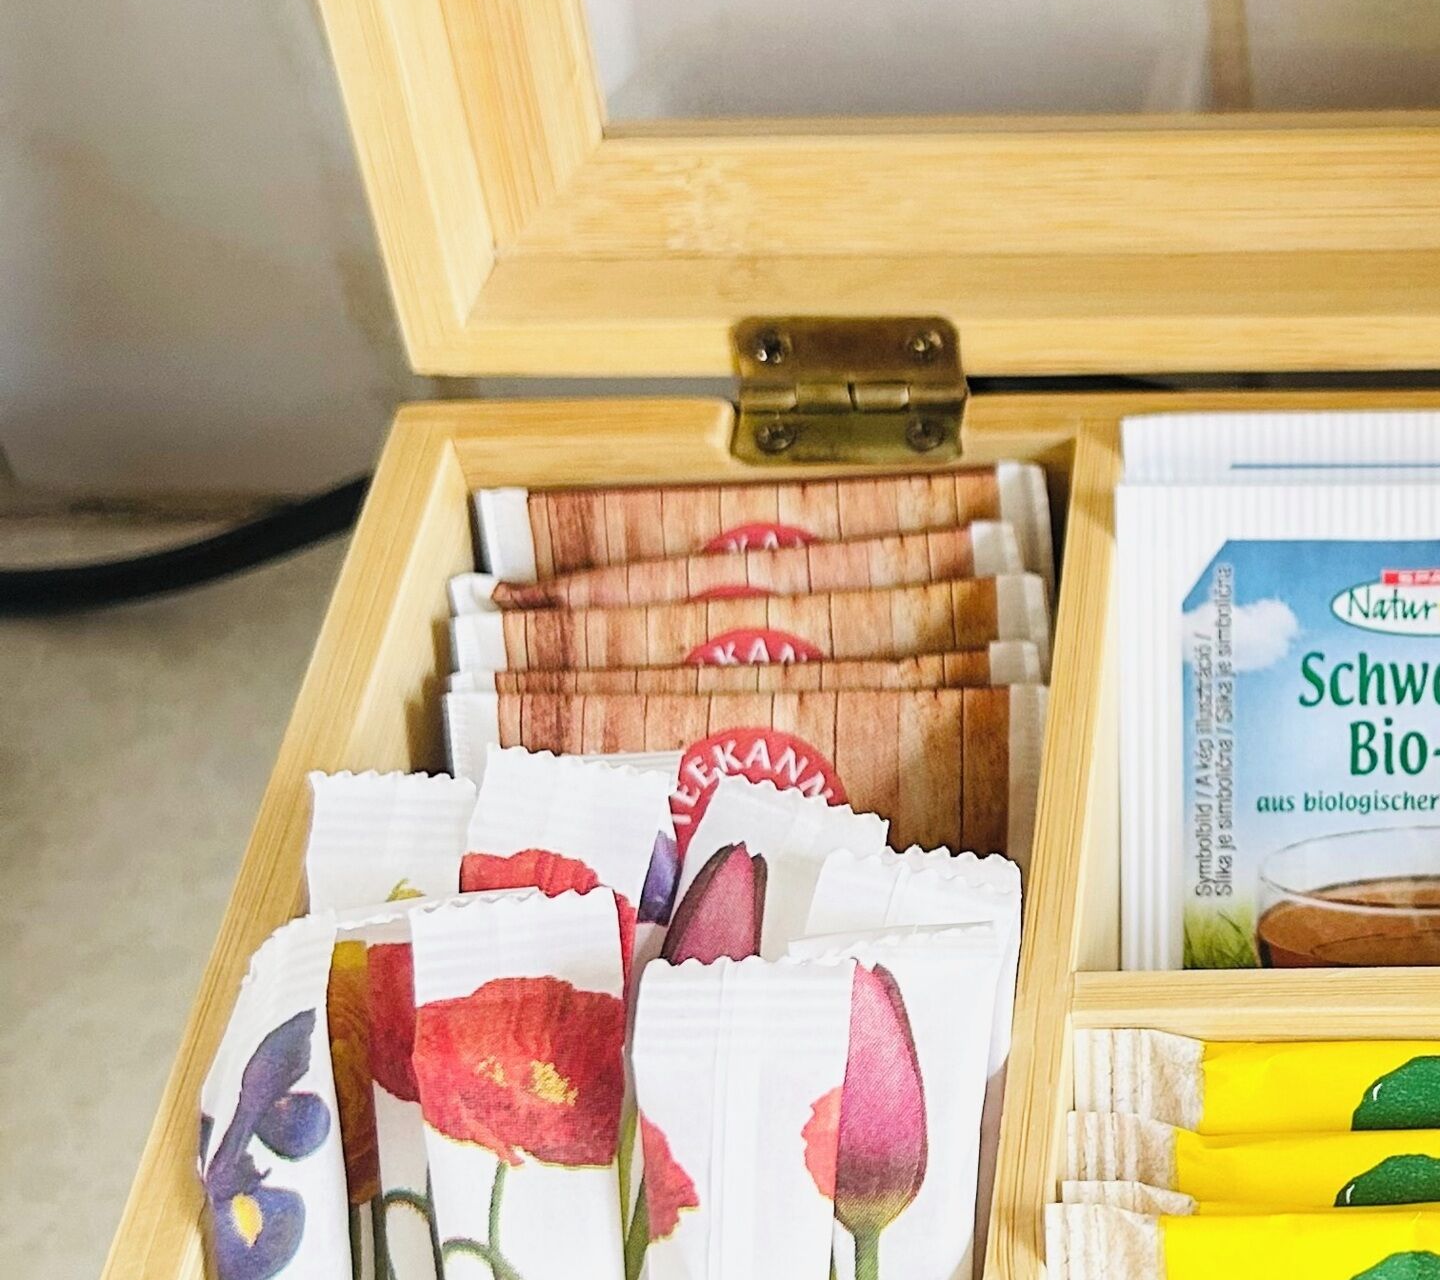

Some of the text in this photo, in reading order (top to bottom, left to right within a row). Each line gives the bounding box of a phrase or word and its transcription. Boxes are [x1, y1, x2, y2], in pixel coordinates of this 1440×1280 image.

[1348, 585, 1438, 620] Natur
[1256, 792, 1296, 813] aus
[1303, 789, 1440, 816] biologischer
[1194, 803, 1214, 897] Symbolbild
